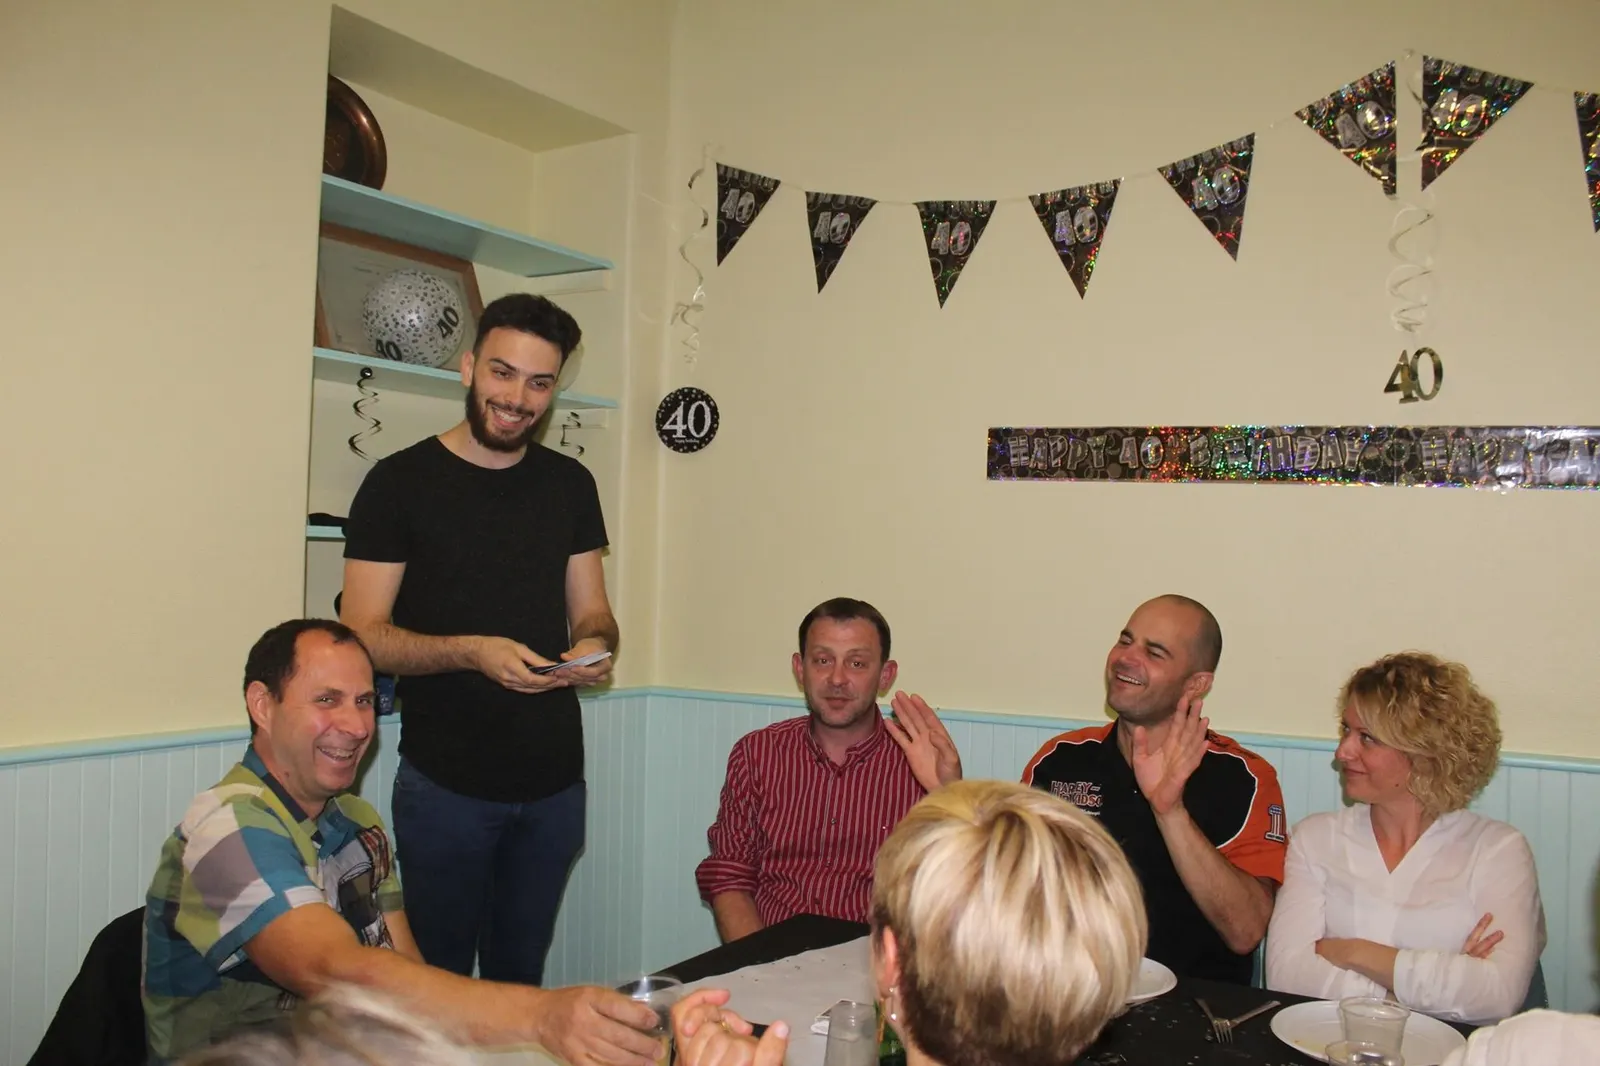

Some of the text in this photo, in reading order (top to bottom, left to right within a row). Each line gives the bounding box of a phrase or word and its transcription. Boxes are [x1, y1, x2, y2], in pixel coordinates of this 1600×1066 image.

[1335, 100, 1387, 148] 40
[1430, 89, 1487, 136] 40
[720, 189, 755, 223] 40
[1192, 167, 1241, 210] 40
[814, 211, 850, 244] 40
[931, 221, 972, 256] 40
[1054, 206, 1099, 246] 40
[437, 306, 460, 339] 40
[375, 339, 403, 361] 40
[1383, 347, 1443, 404] 40
[662, 400, 712, 438] 40
[1007, 434, 1107, 470] HAPPY
